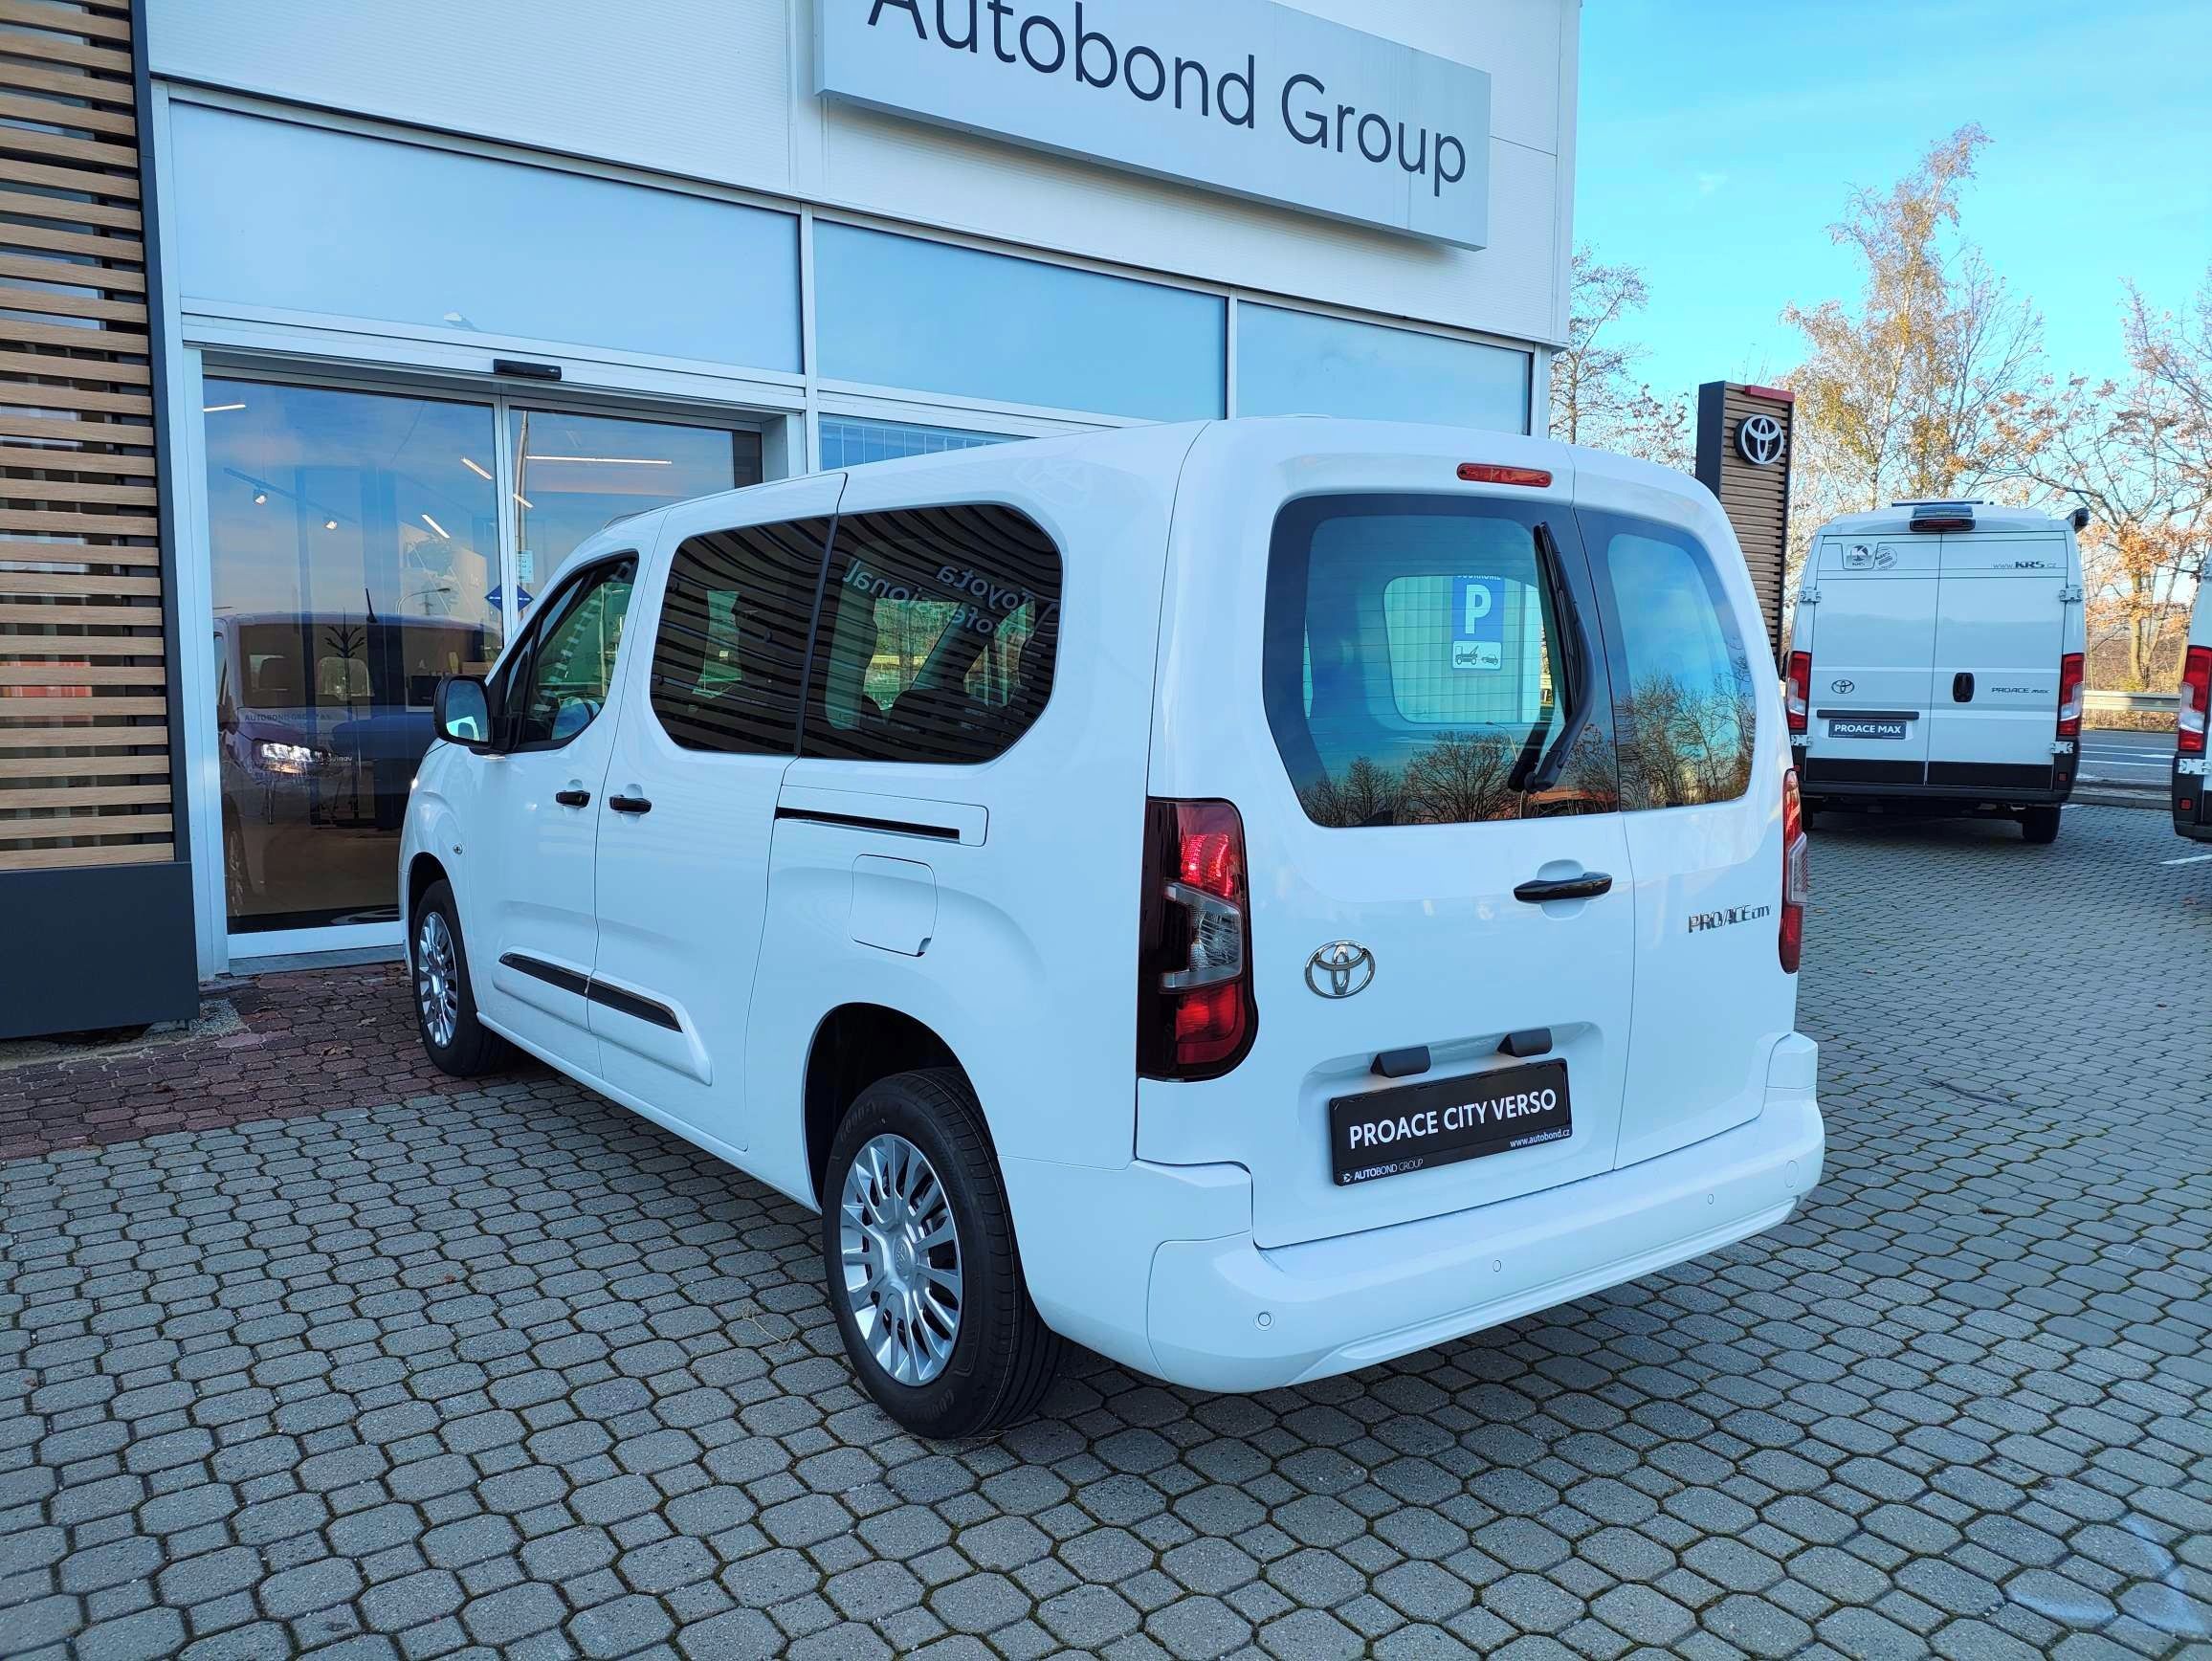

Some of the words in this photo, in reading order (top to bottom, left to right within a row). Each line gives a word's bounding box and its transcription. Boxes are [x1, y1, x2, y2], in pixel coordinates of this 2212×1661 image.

[1280, 73, 1467, 197] Group
[1465, 584, 1492, 634] P
[1834, 724, 1876, 733] PROACE
[1877, 725, 1901, 734] MAX
[1688, 904, 1751, 934] PROACE
[1348, 1111, 1439, 1149] PROACE
[1443, 1101, 1488, 1131] CITY
[1491, 1089, 1557, 1120] VERSO
[1510, 1128, 1570, 1148] www.autobond.cz
[1354, 1163, 1398, 1181] AUTOBOND
[1398, 1158, 1424, 1172] GROUP
